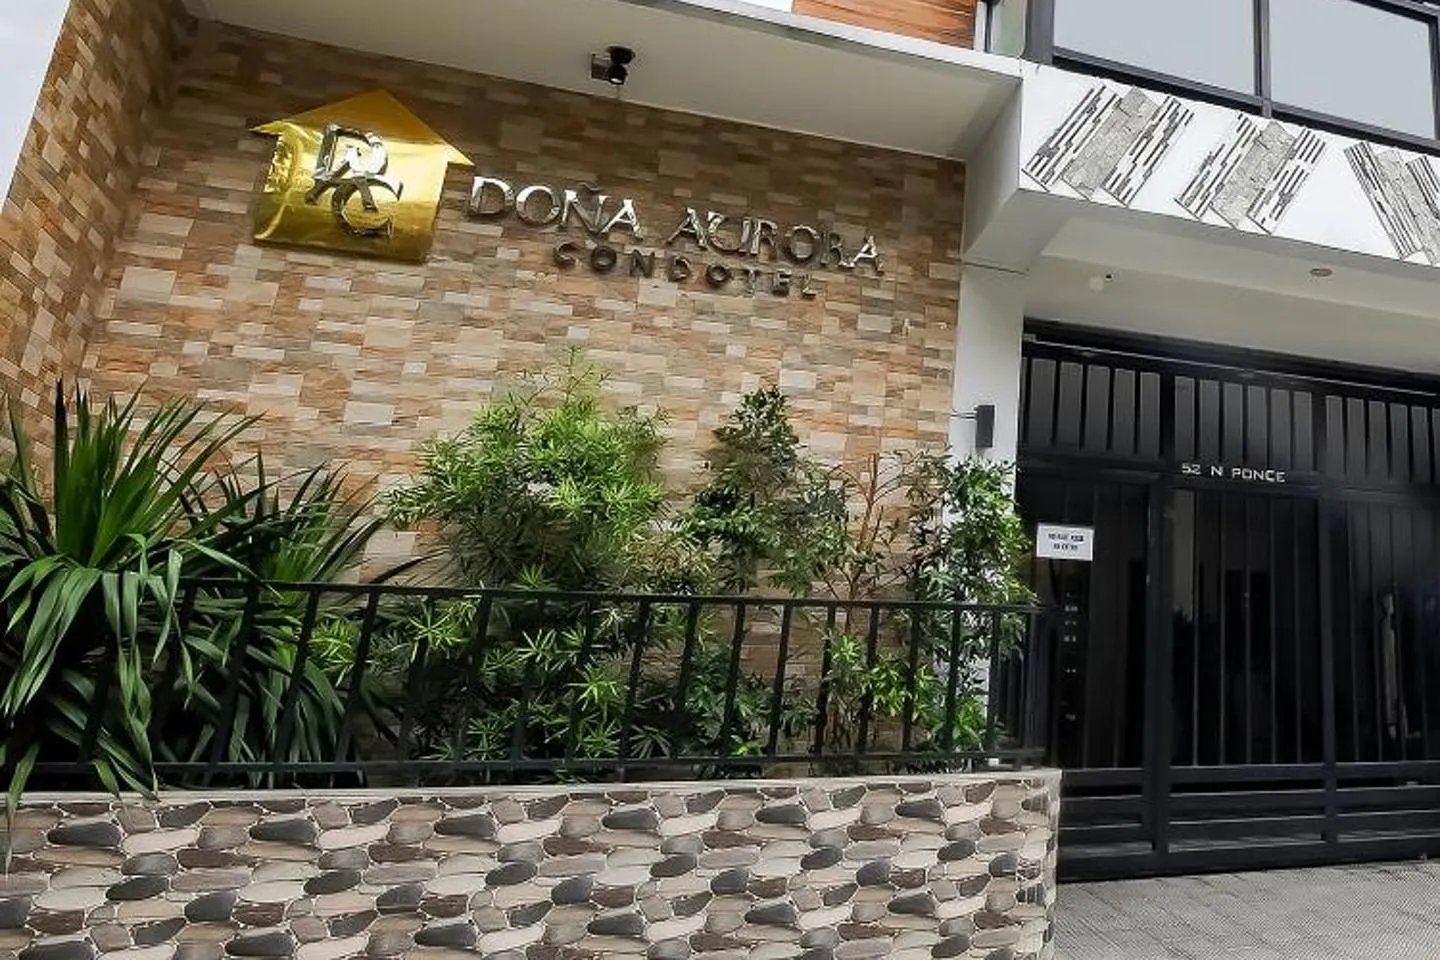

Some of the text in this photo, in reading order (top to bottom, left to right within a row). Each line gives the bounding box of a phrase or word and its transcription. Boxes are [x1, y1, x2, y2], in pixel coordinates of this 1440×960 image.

[469, 175, 885, 272] DOÑA AURORA
[552, 241, 817, 299] CONDOTEL
[1181, 462, 1286, 483] 52 N PONCE
